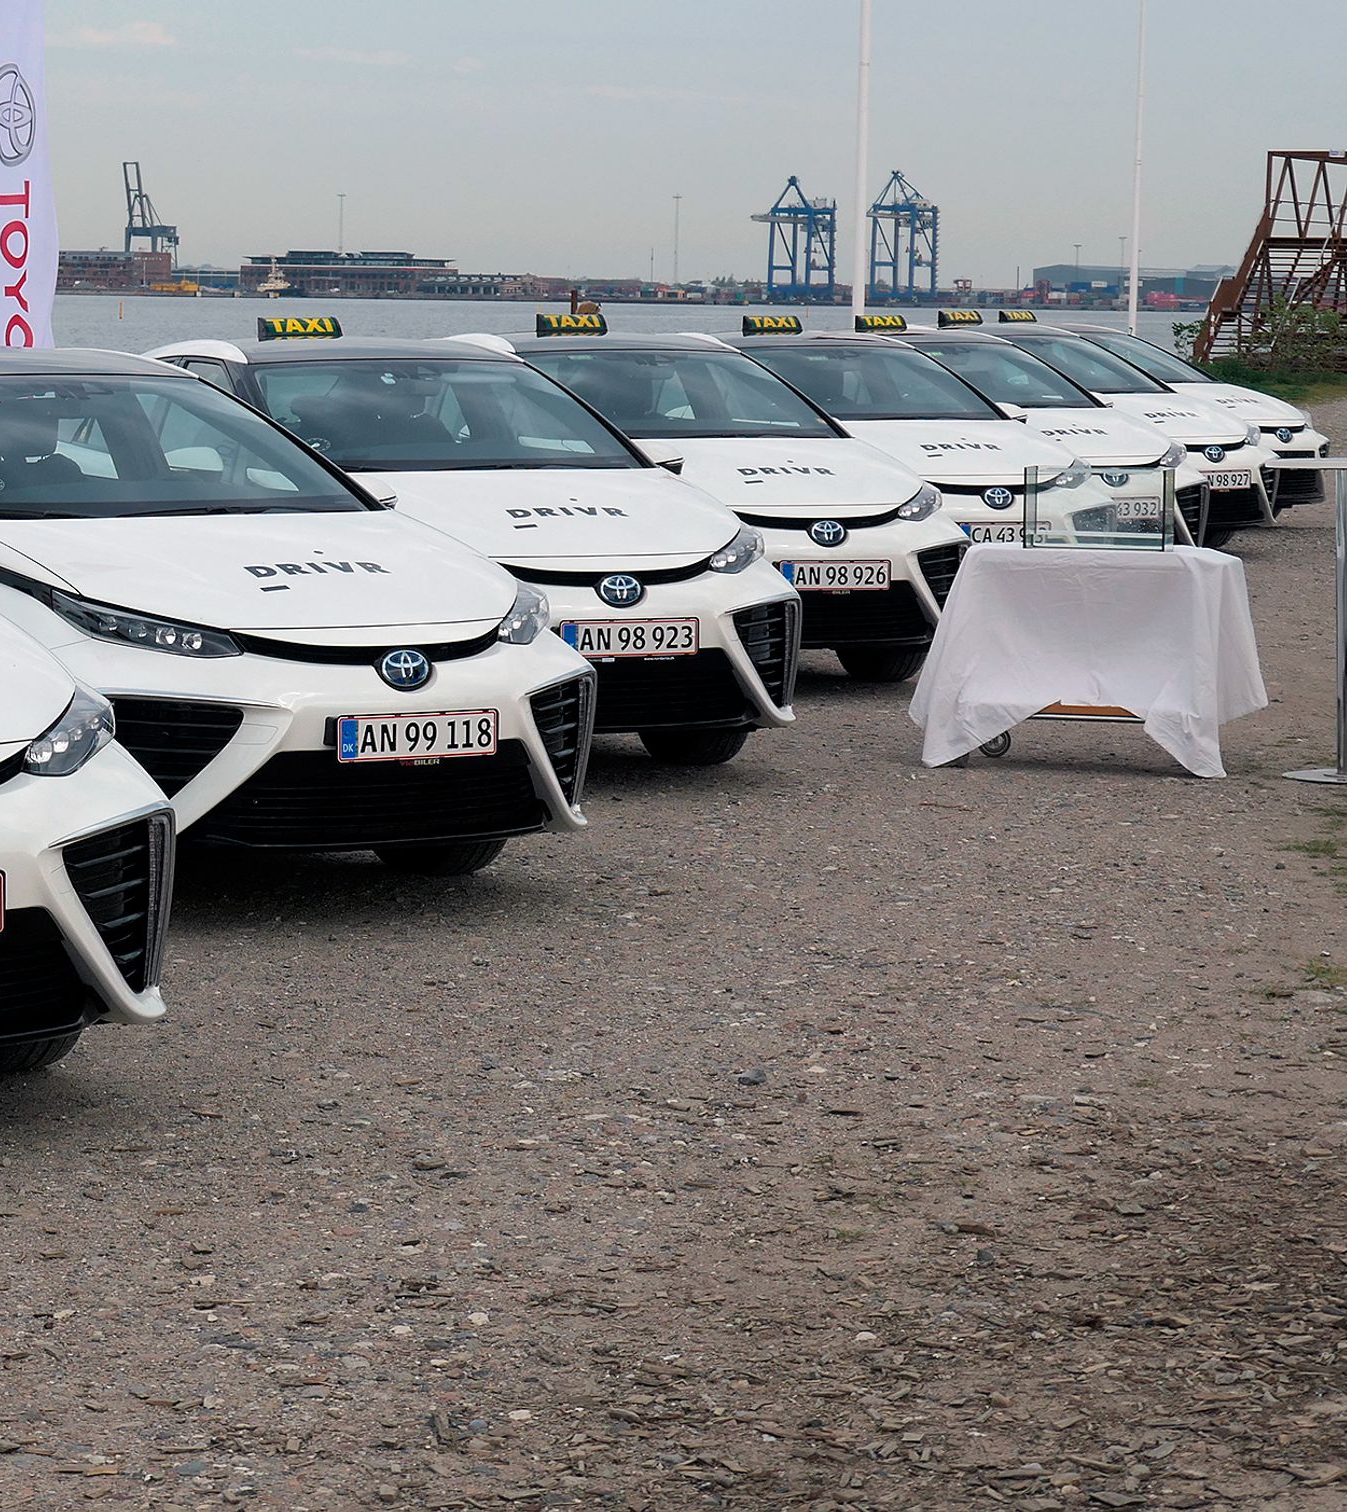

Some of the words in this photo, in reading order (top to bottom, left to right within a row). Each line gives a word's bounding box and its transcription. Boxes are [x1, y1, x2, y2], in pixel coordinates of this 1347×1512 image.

[544, 314, 601, 328] TAXI
[749, 315, 797, 328] TAXI
[863, 315, 902, 327] TAXI
[947, 310, 980, 321] TAXI
[1007, 310, 1034, 320] TAXI
[266, 317, 334, 332] TAXI
[1144, 408, 1199, 418] DRIVR
[1041, 423, 1108, 436] DRIVR
[920, 437, 1002, 451] DRIVR
[736, 460, 836, 476] DRIVR
[1216, 473, 1229, 487] 98
[1231, 473, 1249, 487] 927
[506, 498, 629, 518] DRIVR
[1134, 502, 1157, 516] 932
[971, 527, 993, 543] CA
[996, 527, 1015, 543] 43
[243, 550, 392, 578] DRIVR
[795, 567, 820, 585] AN
[825, 566, 848, 586] 98
[853, 566, 886, 585] 926
[579, 628, 611, 651] AN
[618, 627, 646, 651] 98
[652, 626, 693, 650] 923
[342, 743, 354, 753] DK
[360, 723, 397, 753] AN
[405, 721, 437, 752] 99
[447, 718, 492, 749] 118
